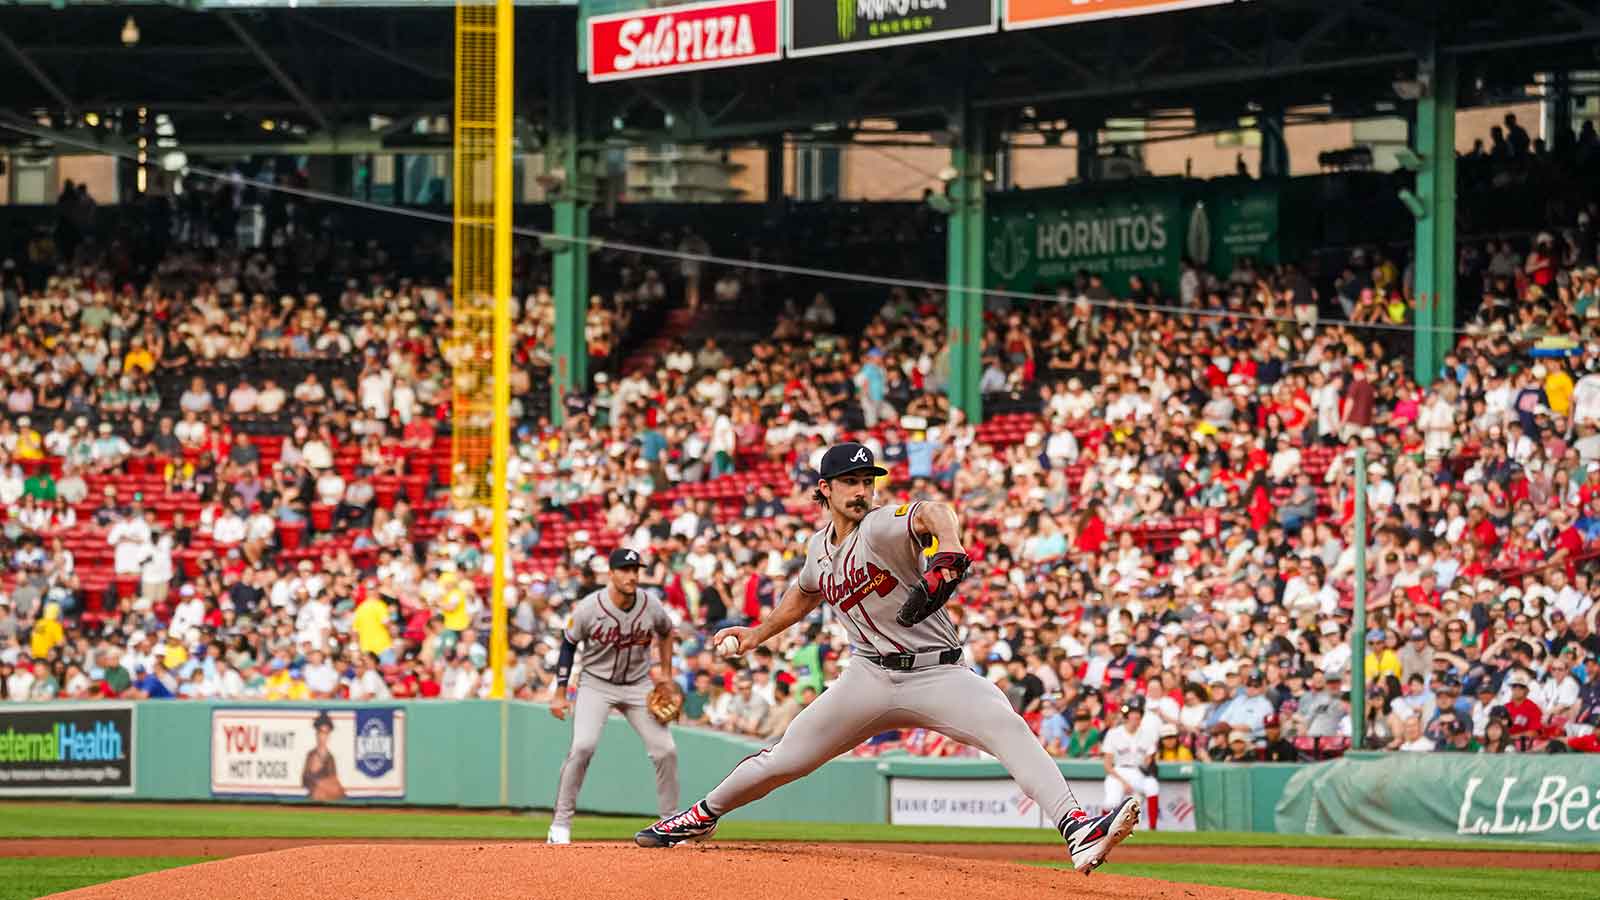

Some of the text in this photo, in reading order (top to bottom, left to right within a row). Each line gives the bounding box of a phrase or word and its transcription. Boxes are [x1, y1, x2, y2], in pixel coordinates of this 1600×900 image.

[868, 15, 934, 36] ENERGY
[676, 13, 756, 62] PIZZA
[1036, 211, 1168, 259] HORNITOS
[849, 447, 869, 464] A
[223, 724, 297, 754] YOU WANT
[228, 760, 289, 780] HOT DOGS
[895, 799, 1007, 815] BANK OF AMERICA
